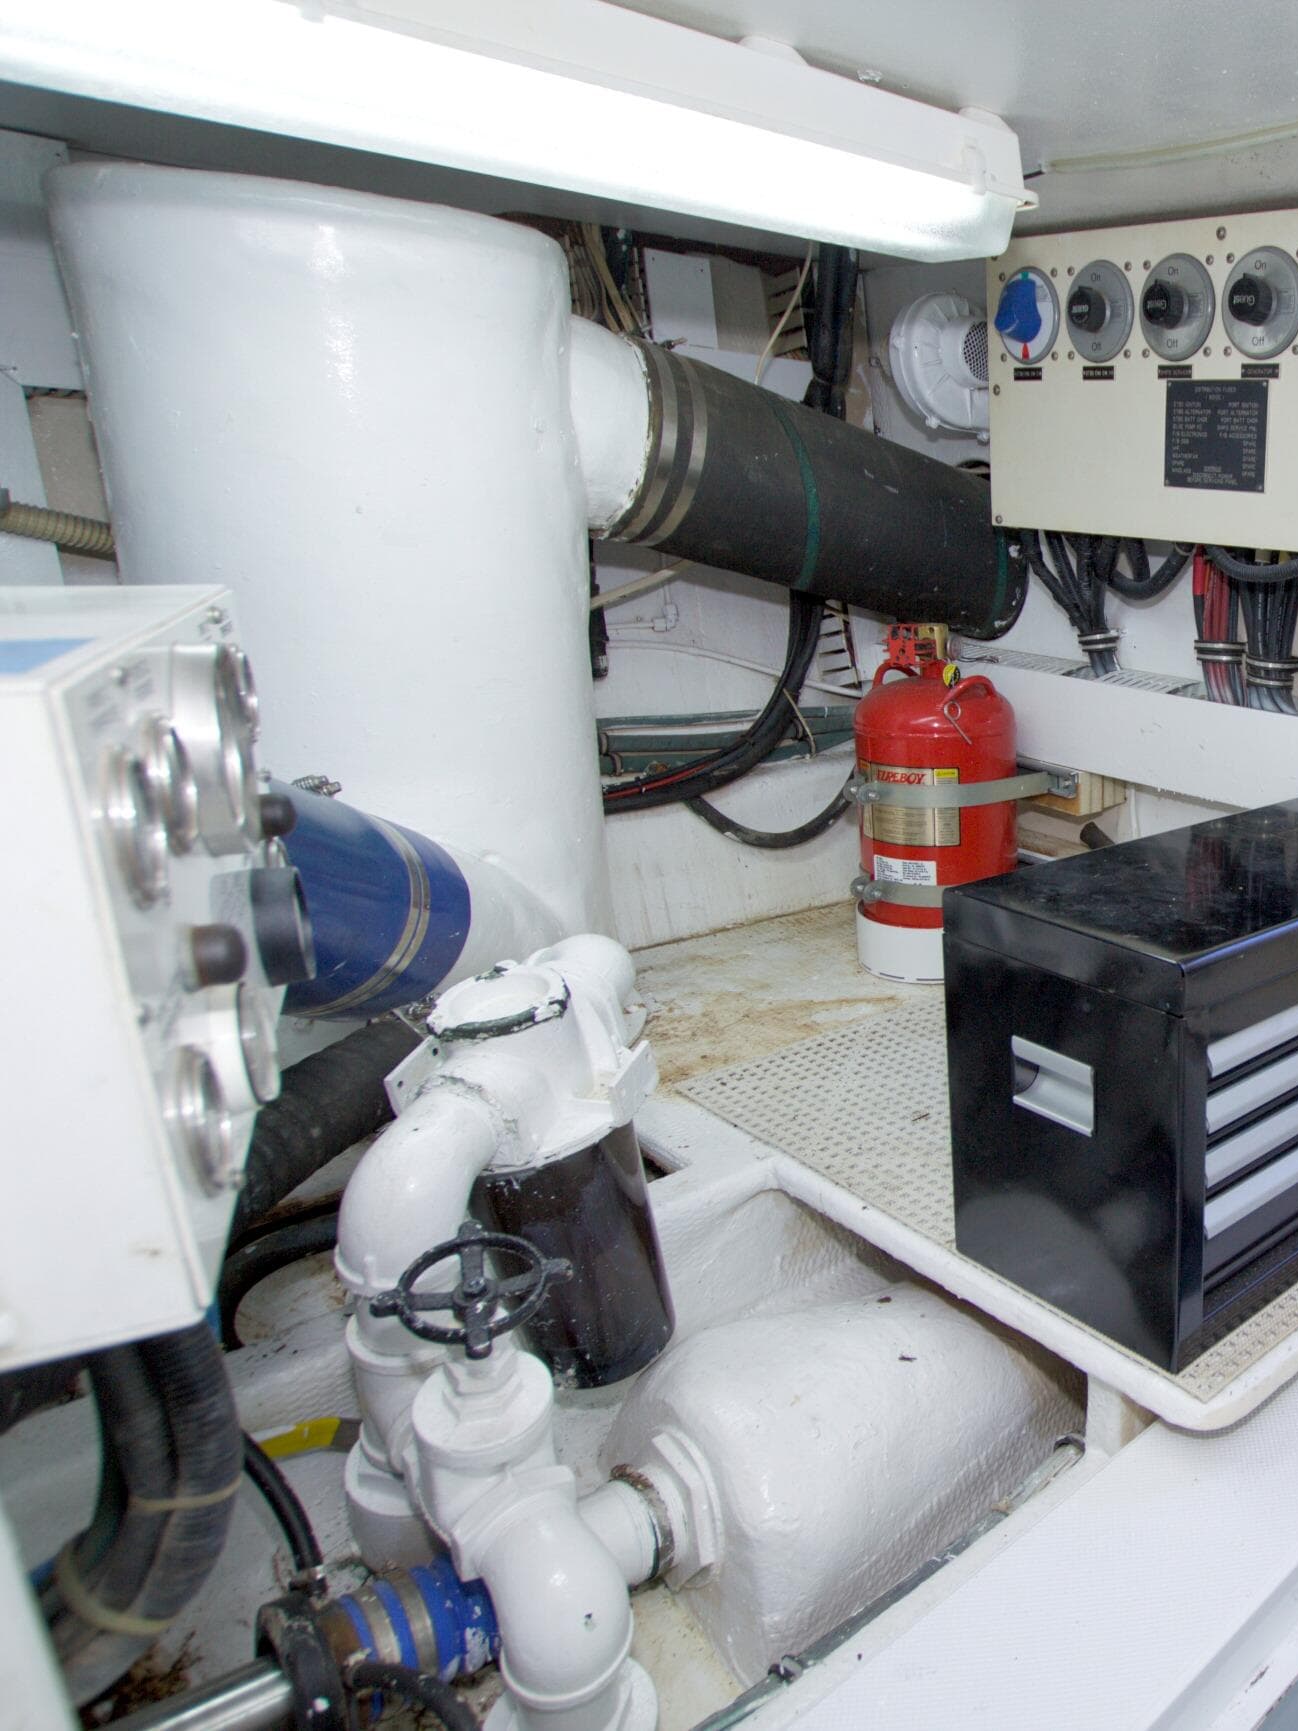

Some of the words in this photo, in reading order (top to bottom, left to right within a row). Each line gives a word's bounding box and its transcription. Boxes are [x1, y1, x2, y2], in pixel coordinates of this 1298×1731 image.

[1254, 259, 1267, 270] On
[1167, 265, 1179, 276] On
[1090, 273, 1101, 281] On
[1166, 338, 1178, 348] Off
[1251, 336, 1265, 346] Off
[1091, 343, 1101, 352] Off
